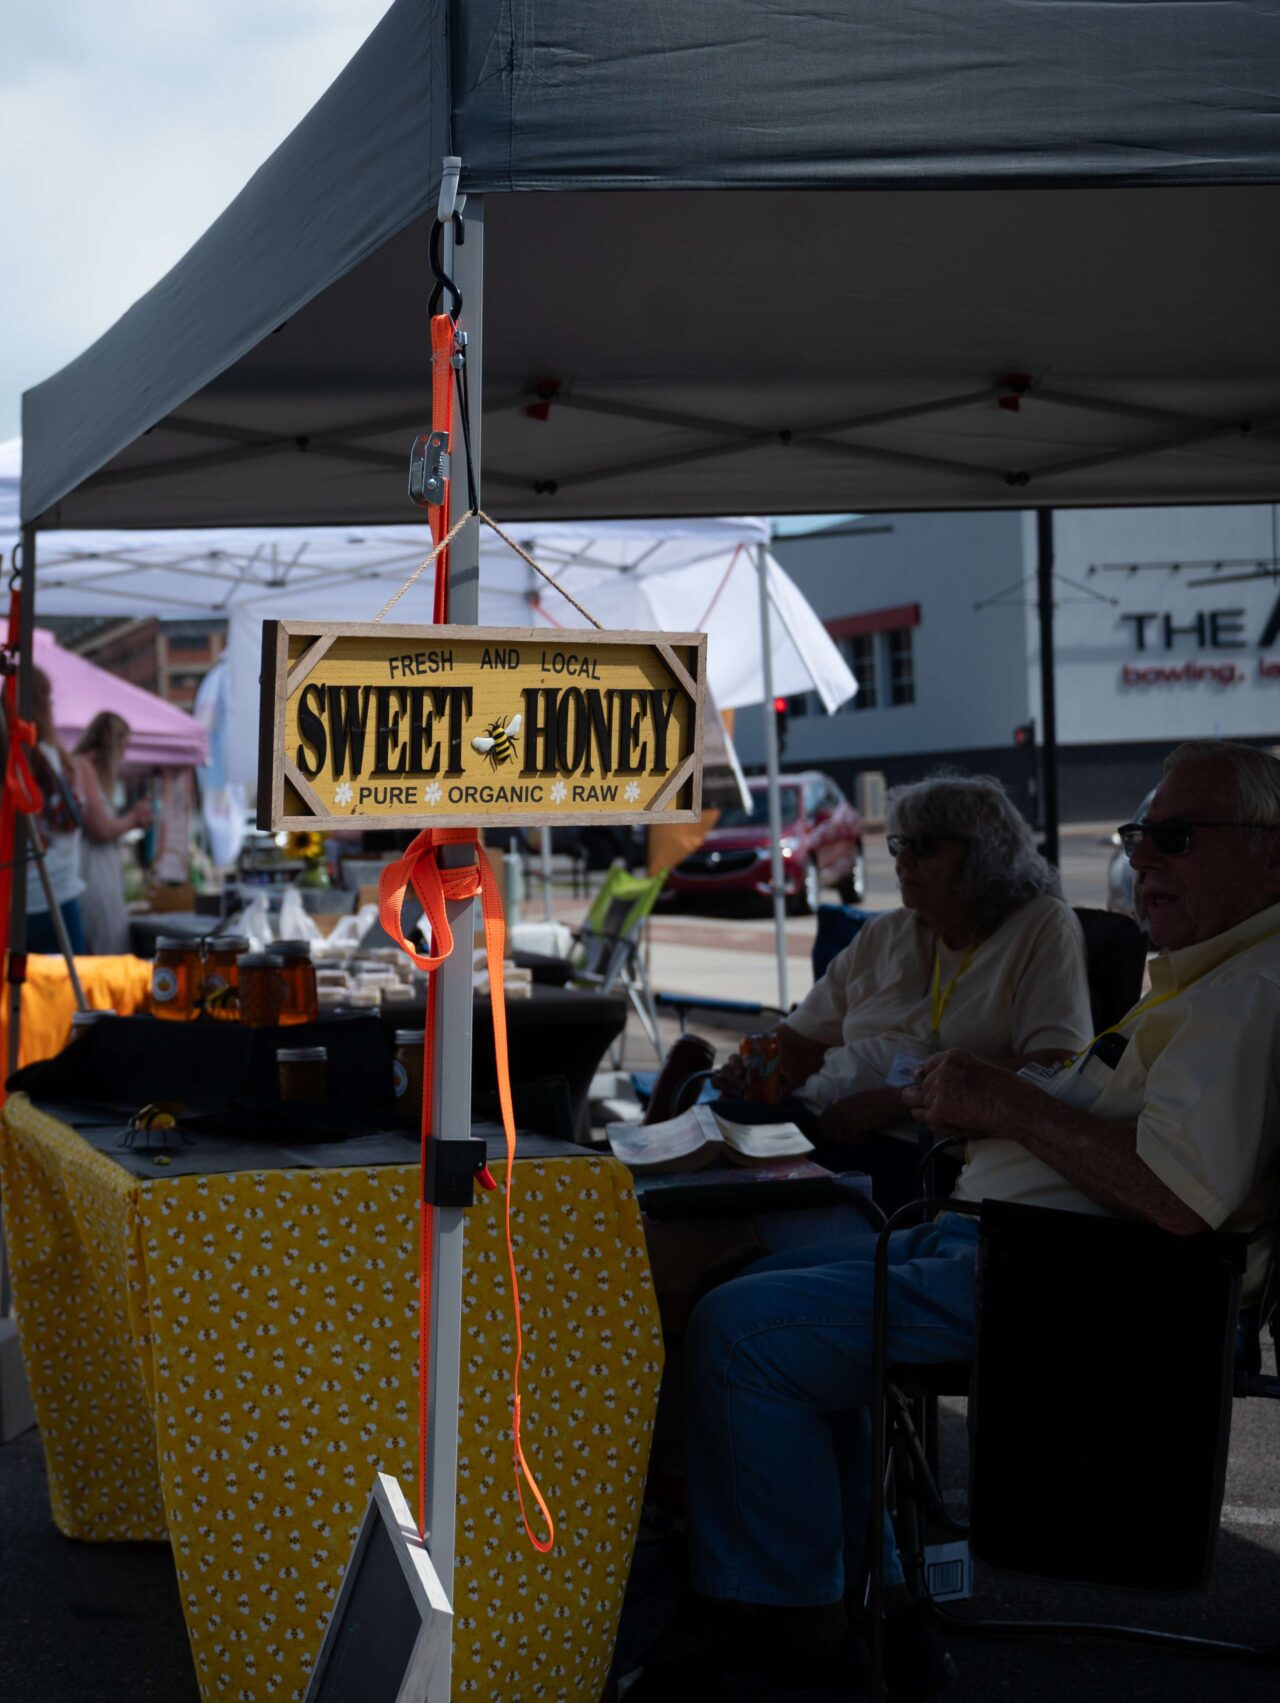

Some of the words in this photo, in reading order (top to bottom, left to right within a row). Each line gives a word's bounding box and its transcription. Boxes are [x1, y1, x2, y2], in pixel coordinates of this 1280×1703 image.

[1121, 609, 1246, 651] THE
[388, 650, 454, 680] FRESH
[480, 648, 520, 671] AND
[541, 651, 601, 680] LOCAL
[297, 683, 473, 778] SWEET
[521, 686, 678, 774] HONEY
[359, 786, 418, 805] PURE
[448, 786, 544, 804] ORGANIC
[573, 786, 618, 802] RAW
